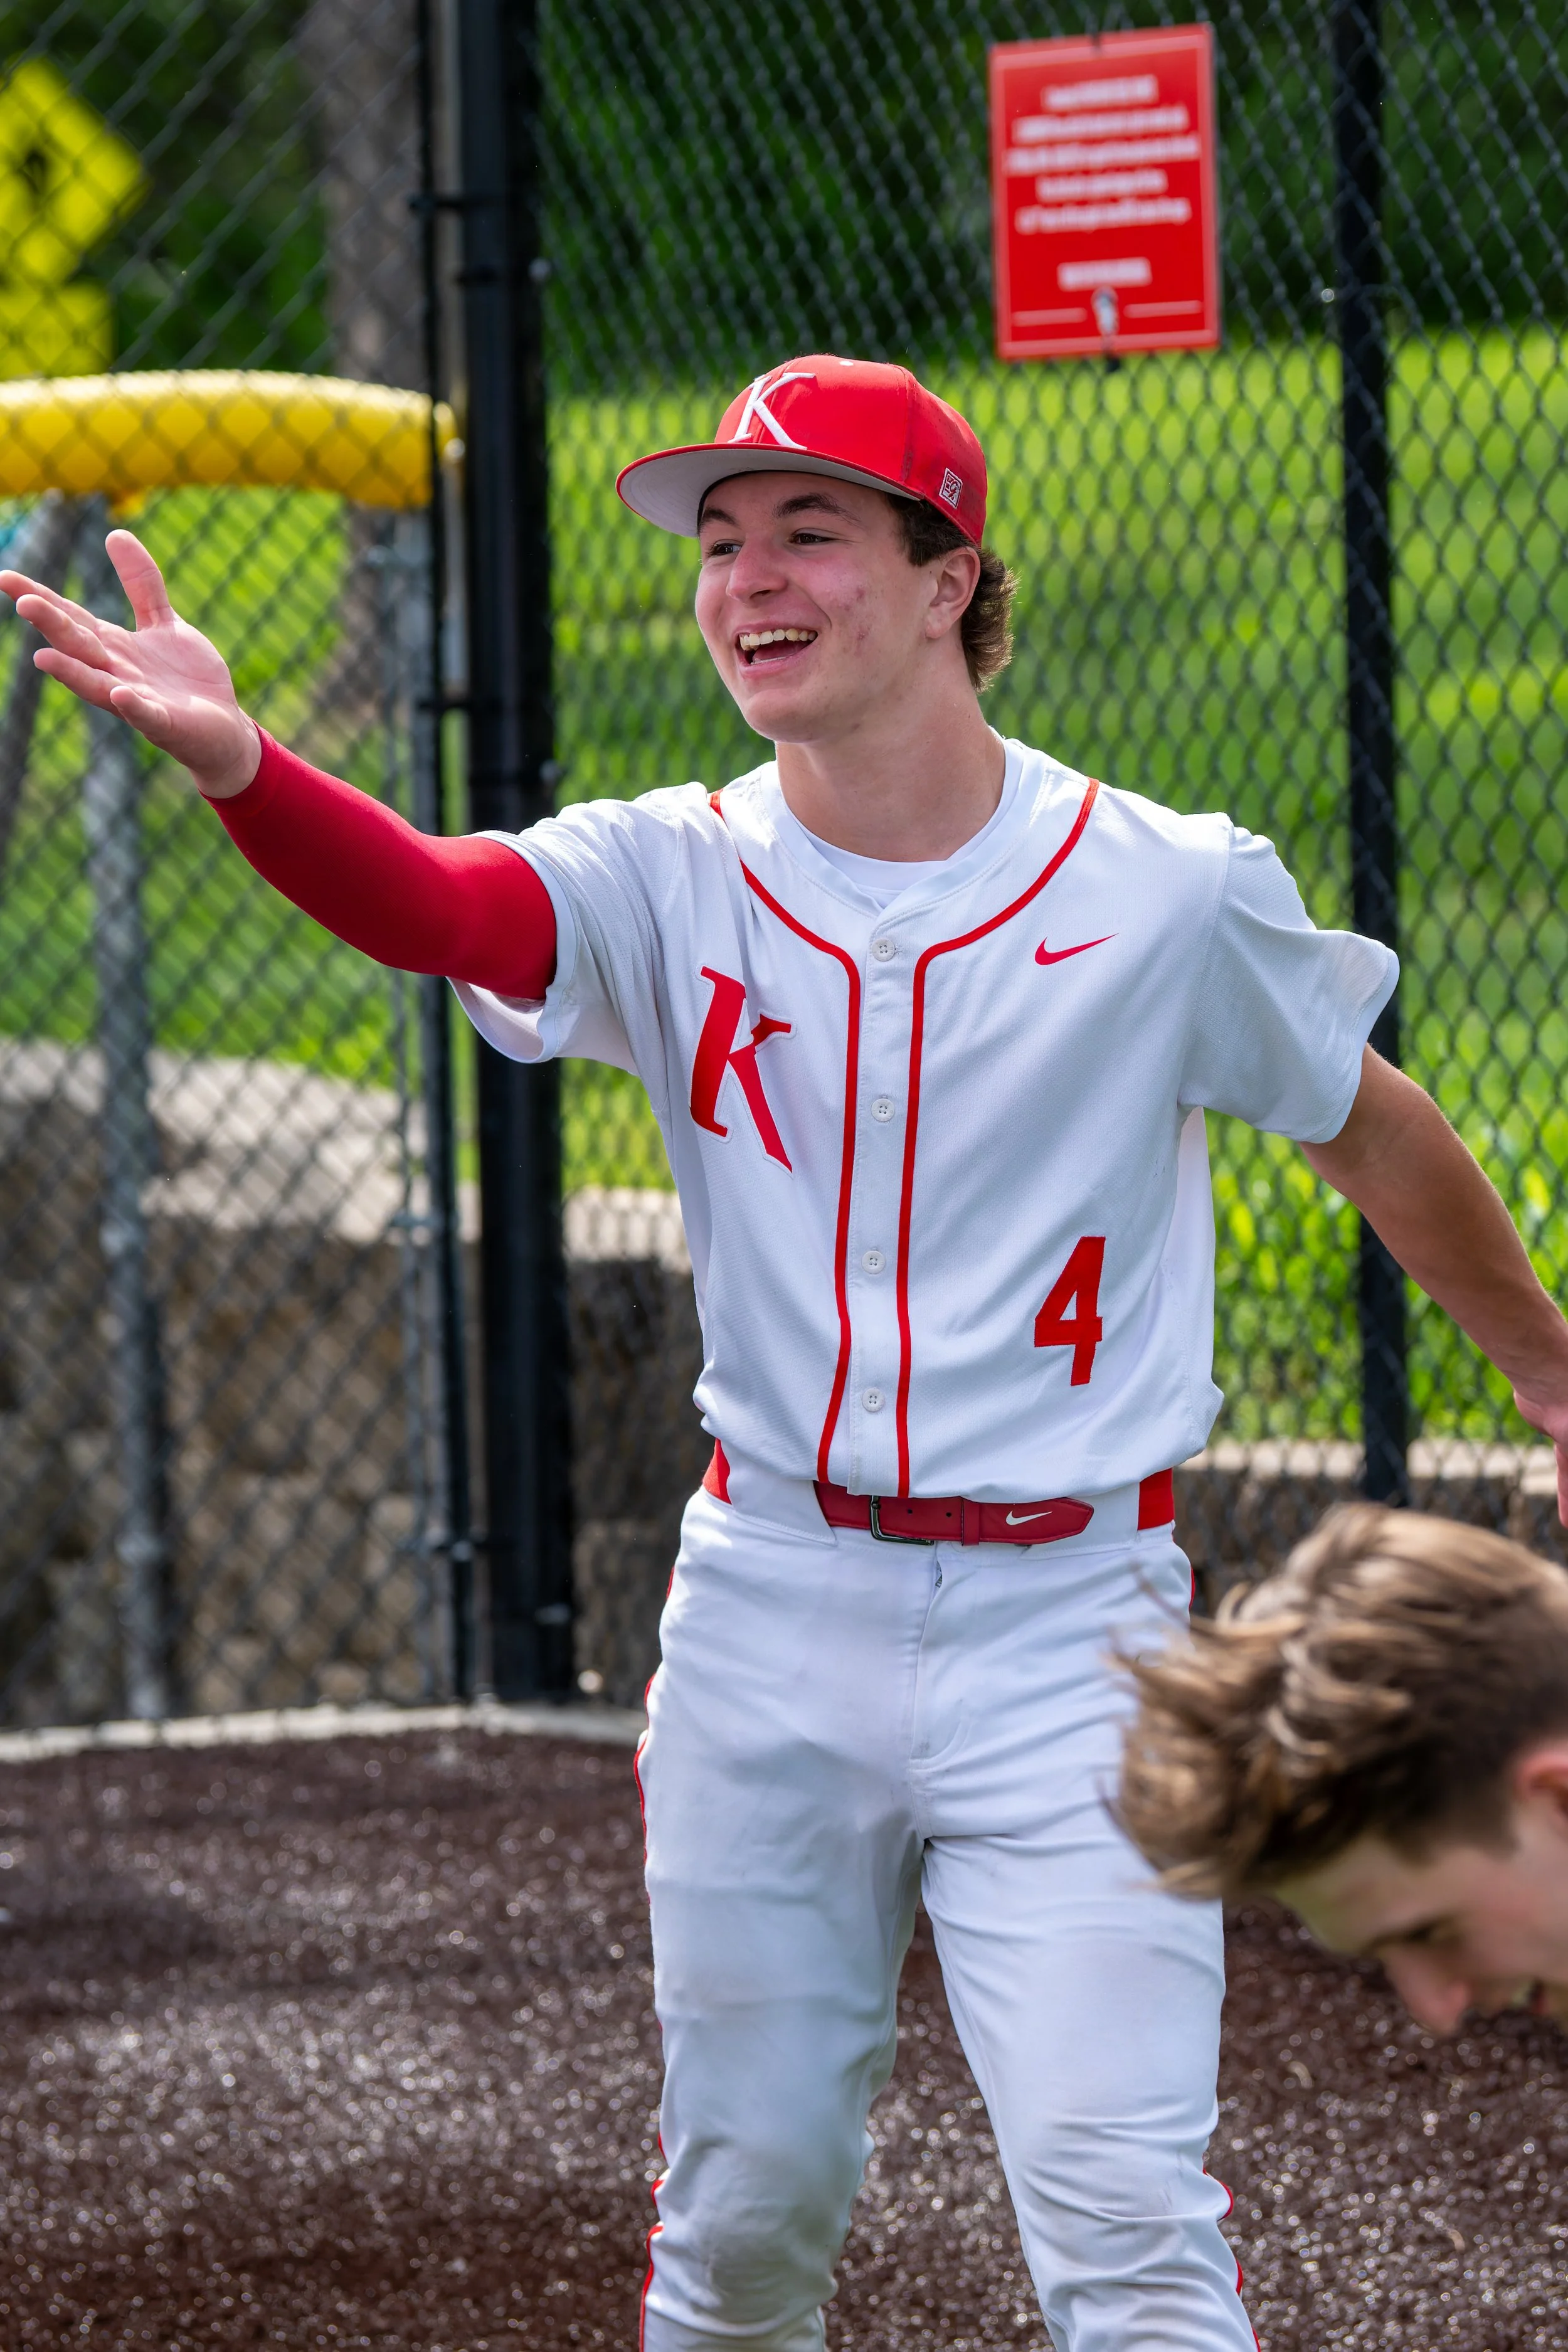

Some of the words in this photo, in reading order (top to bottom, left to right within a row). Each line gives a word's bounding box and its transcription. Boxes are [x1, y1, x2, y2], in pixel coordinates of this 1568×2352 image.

[727, 372, 816, 450] K
[690, 965, 792, 1173] K
[1034, 1236, 1106, 1386] 4
